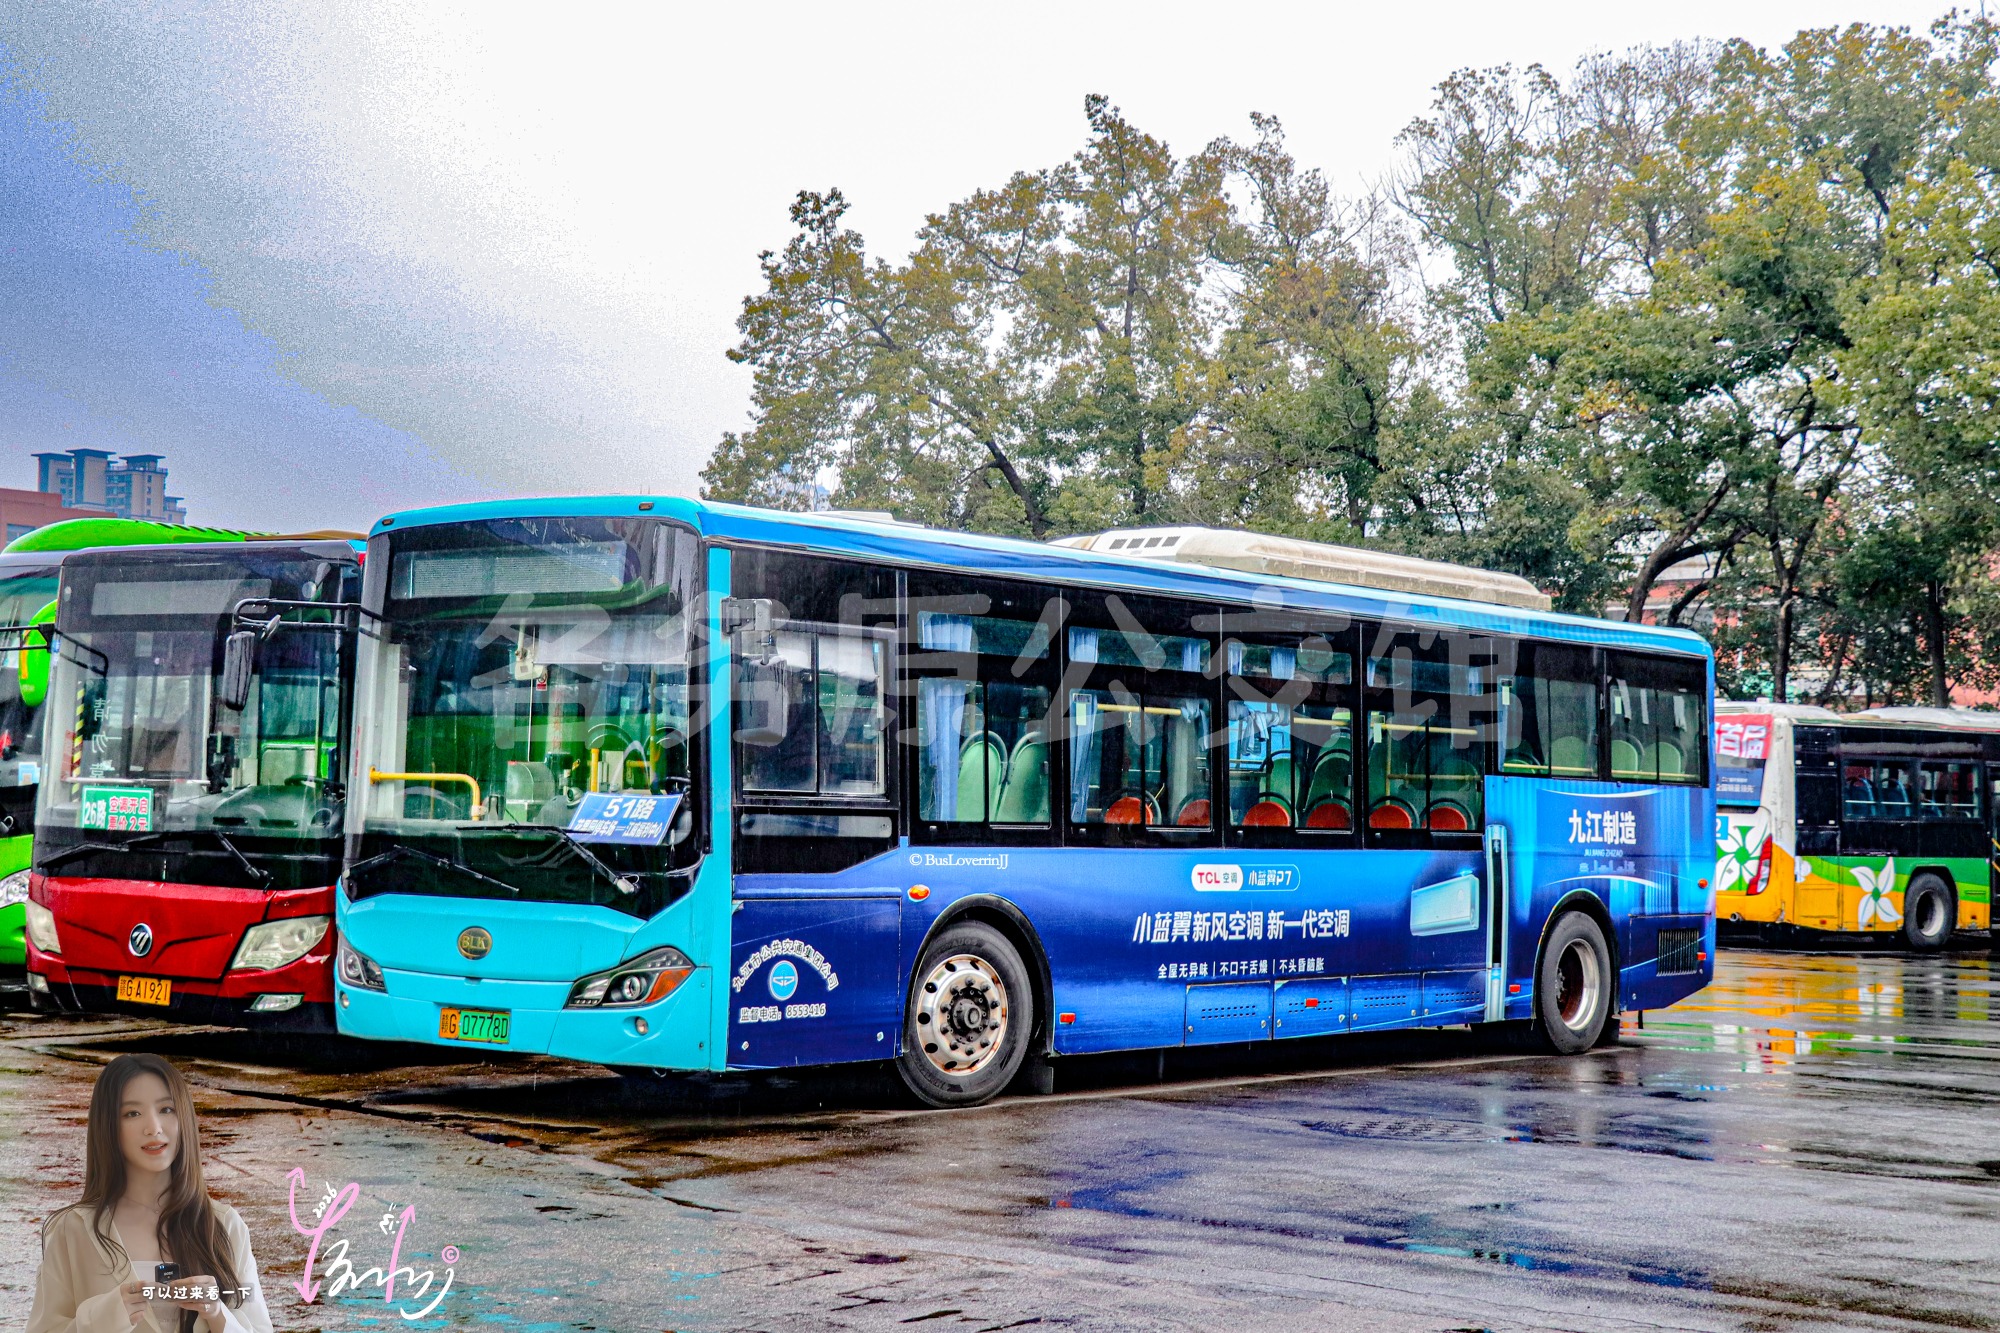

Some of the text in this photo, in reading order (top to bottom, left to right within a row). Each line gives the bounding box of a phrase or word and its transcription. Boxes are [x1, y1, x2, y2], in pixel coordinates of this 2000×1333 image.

[84, 799, 107, 828] 26路
[109, 796, 149, 814] 空调开启
[603, 797, 658, 819] 51路
[1568, 809, 1637, 845] 九江制造
[1197, 871, 1221, 884] TCL
[1222, 872, 1238, 884] 空调
[1132, 908, 1350, 944] 小蓝翼新风空调 新一代空调
[461, 935, 486, 950] BLK
[731, 938, 840, 992] 九江市公共交通集团公司
[1157, 957, 1325, 979] 全屋无异味 不口干舌燥 不头昏脑胀
